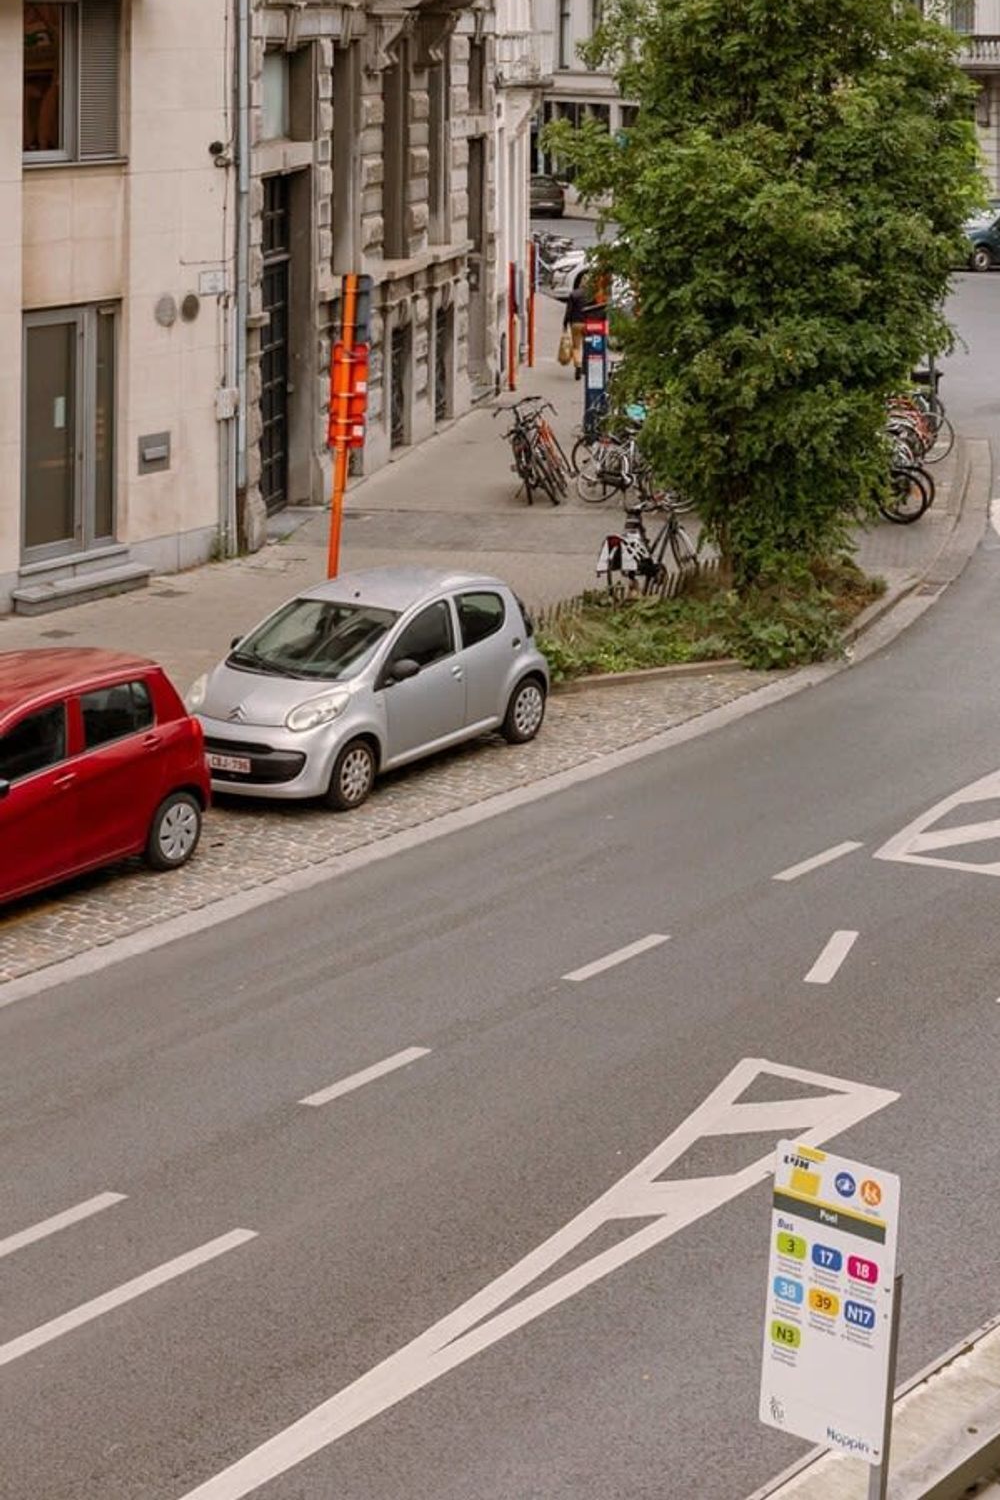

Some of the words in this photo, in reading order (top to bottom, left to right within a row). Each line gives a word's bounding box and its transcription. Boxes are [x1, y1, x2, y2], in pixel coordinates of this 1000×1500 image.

[787, 1238, 795, 1253] 3
[820, 1250, 834, 1266] 17
[855, 1262, 870, 1279] 18
[780, 1280, 796, 1299] 38
[815, 1293, 832, 1310] 39
[847, 1304, 872, 1325] N17
[776, 1326, 795, 1343] N3
